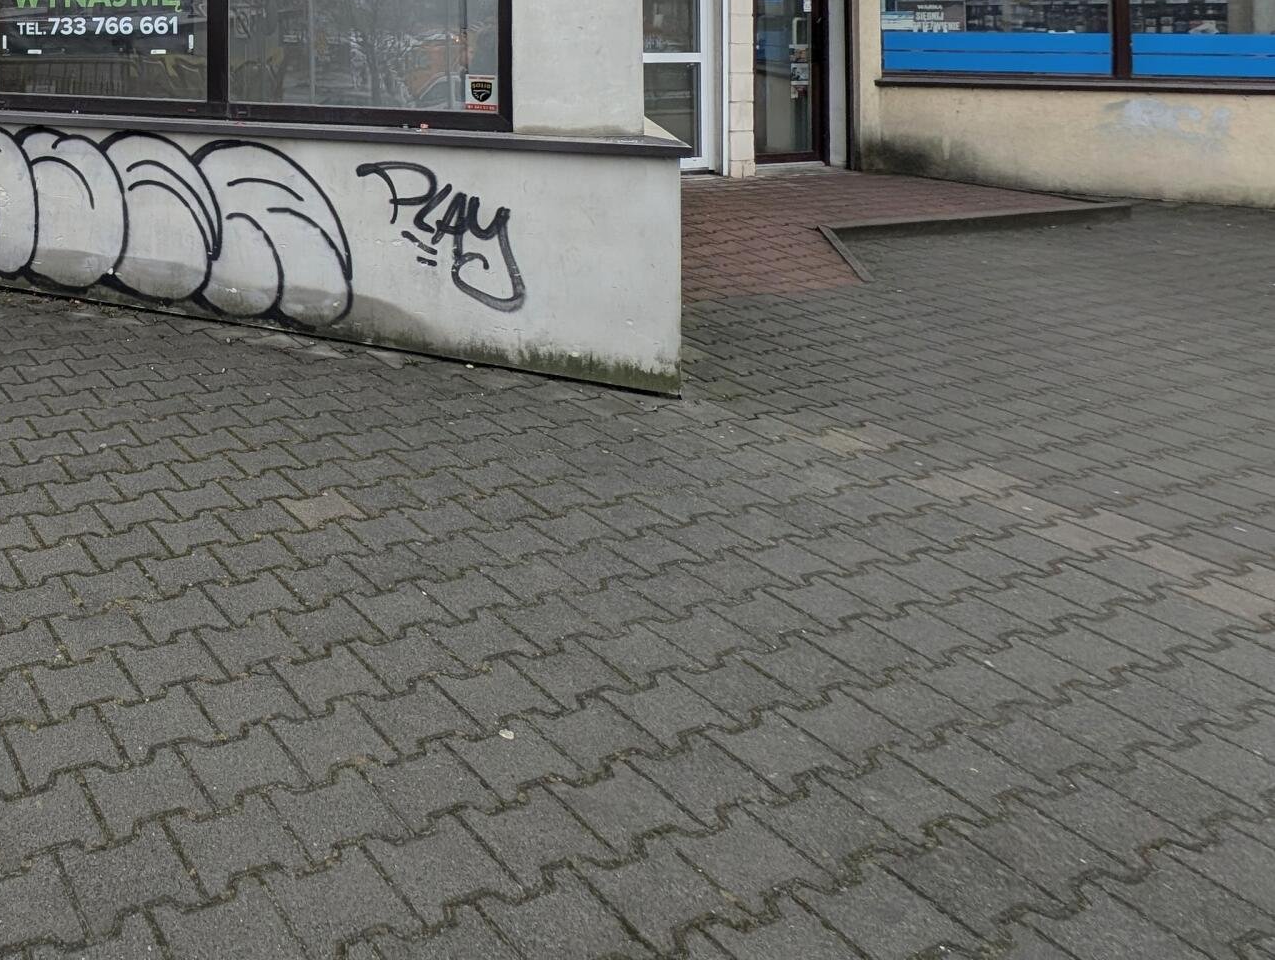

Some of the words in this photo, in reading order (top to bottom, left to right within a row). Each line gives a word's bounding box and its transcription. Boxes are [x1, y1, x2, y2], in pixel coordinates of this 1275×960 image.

[16, 22, 47, 35] TEL.
[48, 17, 86, 35] 733
[92, 17, 133, 35] 766
[139, 16, 178, 35] 661
